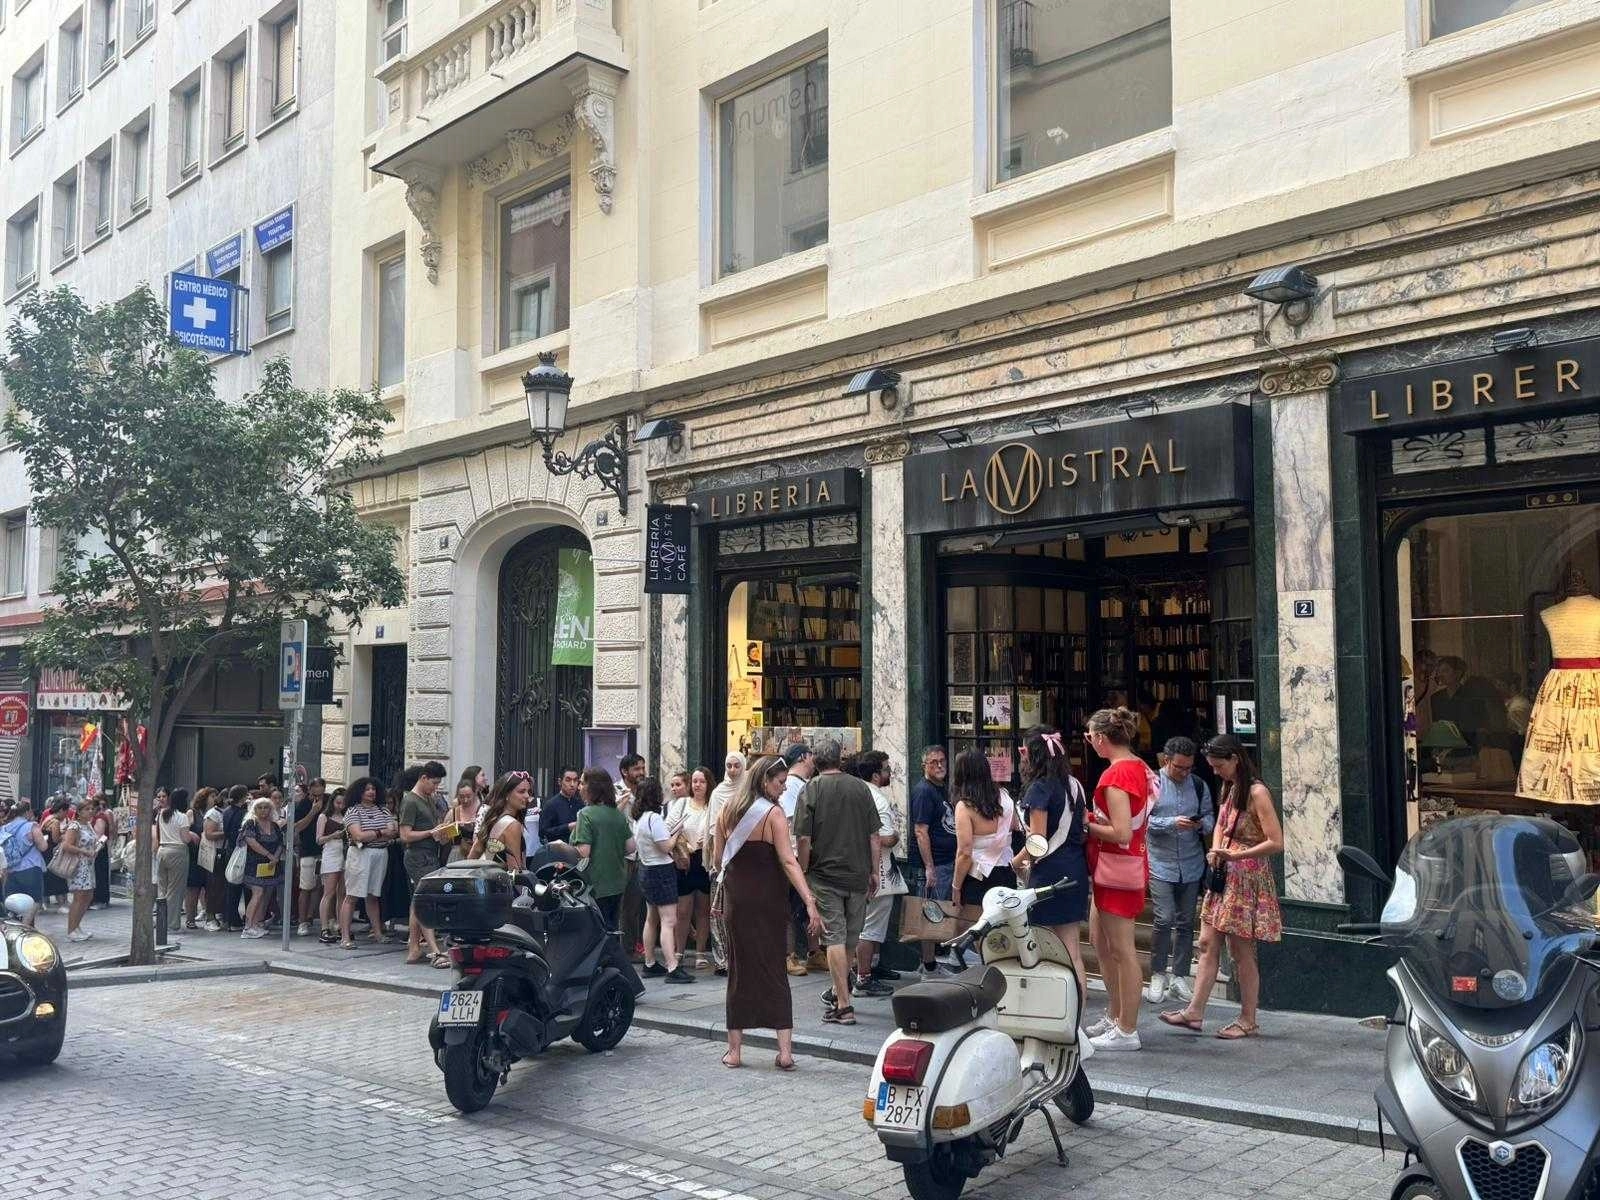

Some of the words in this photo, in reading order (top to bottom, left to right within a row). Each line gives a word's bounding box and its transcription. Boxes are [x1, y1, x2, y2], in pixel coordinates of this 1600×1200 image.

[739, 80, 816, 131] numen
[174, 279, 202, 294] CENTRO
[1370, 359, 1581, 420] LIBRER
[941, 469, 979, 501] LA
[984, 439, 1187, 515] MISTRAL
[711, 478, 831, 517] LIBRERÍA
[660, 513, 677, 564] MISTR
[663, 565, 672, 581] LA
[677, 544, 687, 581] CAFÉ
[1300, 603, 1308, 614] 2
[305, 669, 329, 679] men
[239, 743, 254, 758] 20
[450, 993, 480, 1007] 2624
[451, 1006, 475, 1020] LLH
[888, 1086, 897, 1104] B
[905, 1088, 924, 1108] FX
[884, 1105, 922, 1127] 2871
